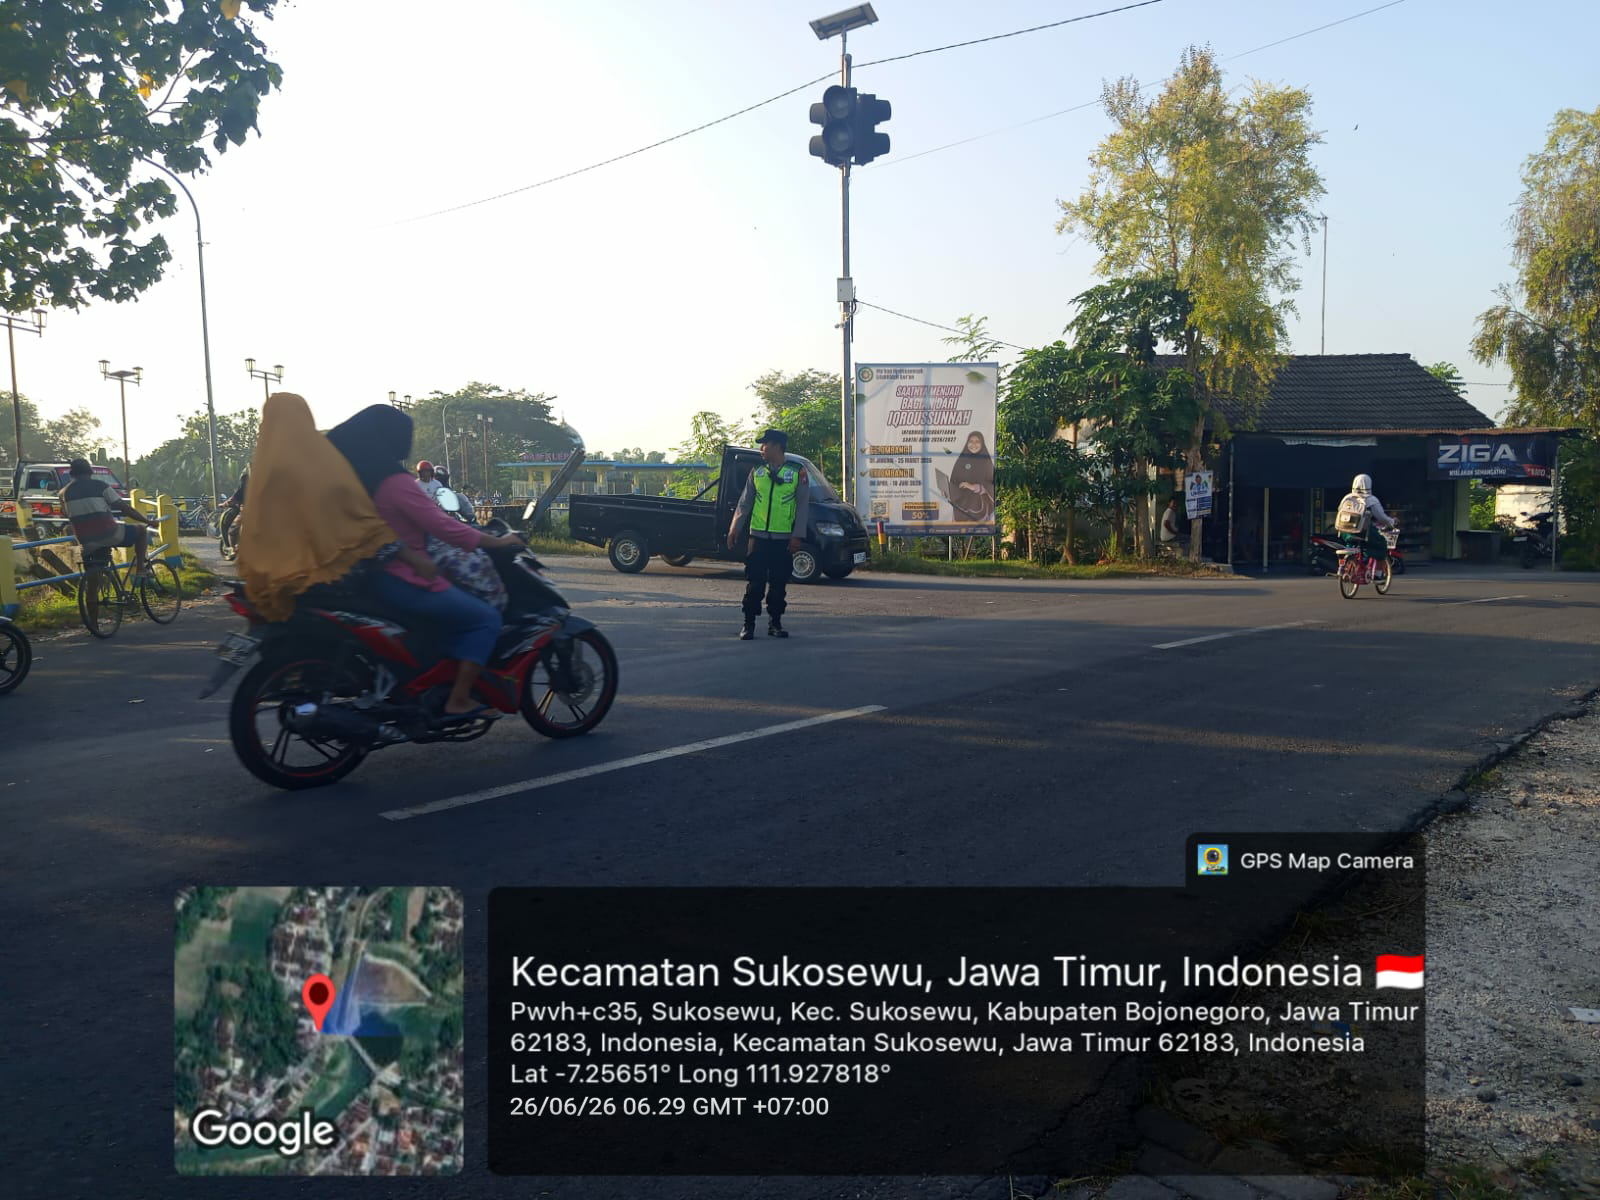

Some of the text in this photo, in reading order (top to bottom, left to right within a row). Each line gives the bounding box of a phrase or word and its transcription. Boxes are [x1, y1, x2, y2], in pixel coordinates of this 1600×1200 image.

[896, 385, 964, 397] SAATNYA MENJADI
[900, 396, 960, 410] BAGIAN DARI
[887, 410, 972, 428] IQROUSSUNNAH
[1438, 440, 1516, 463] ZIGA
